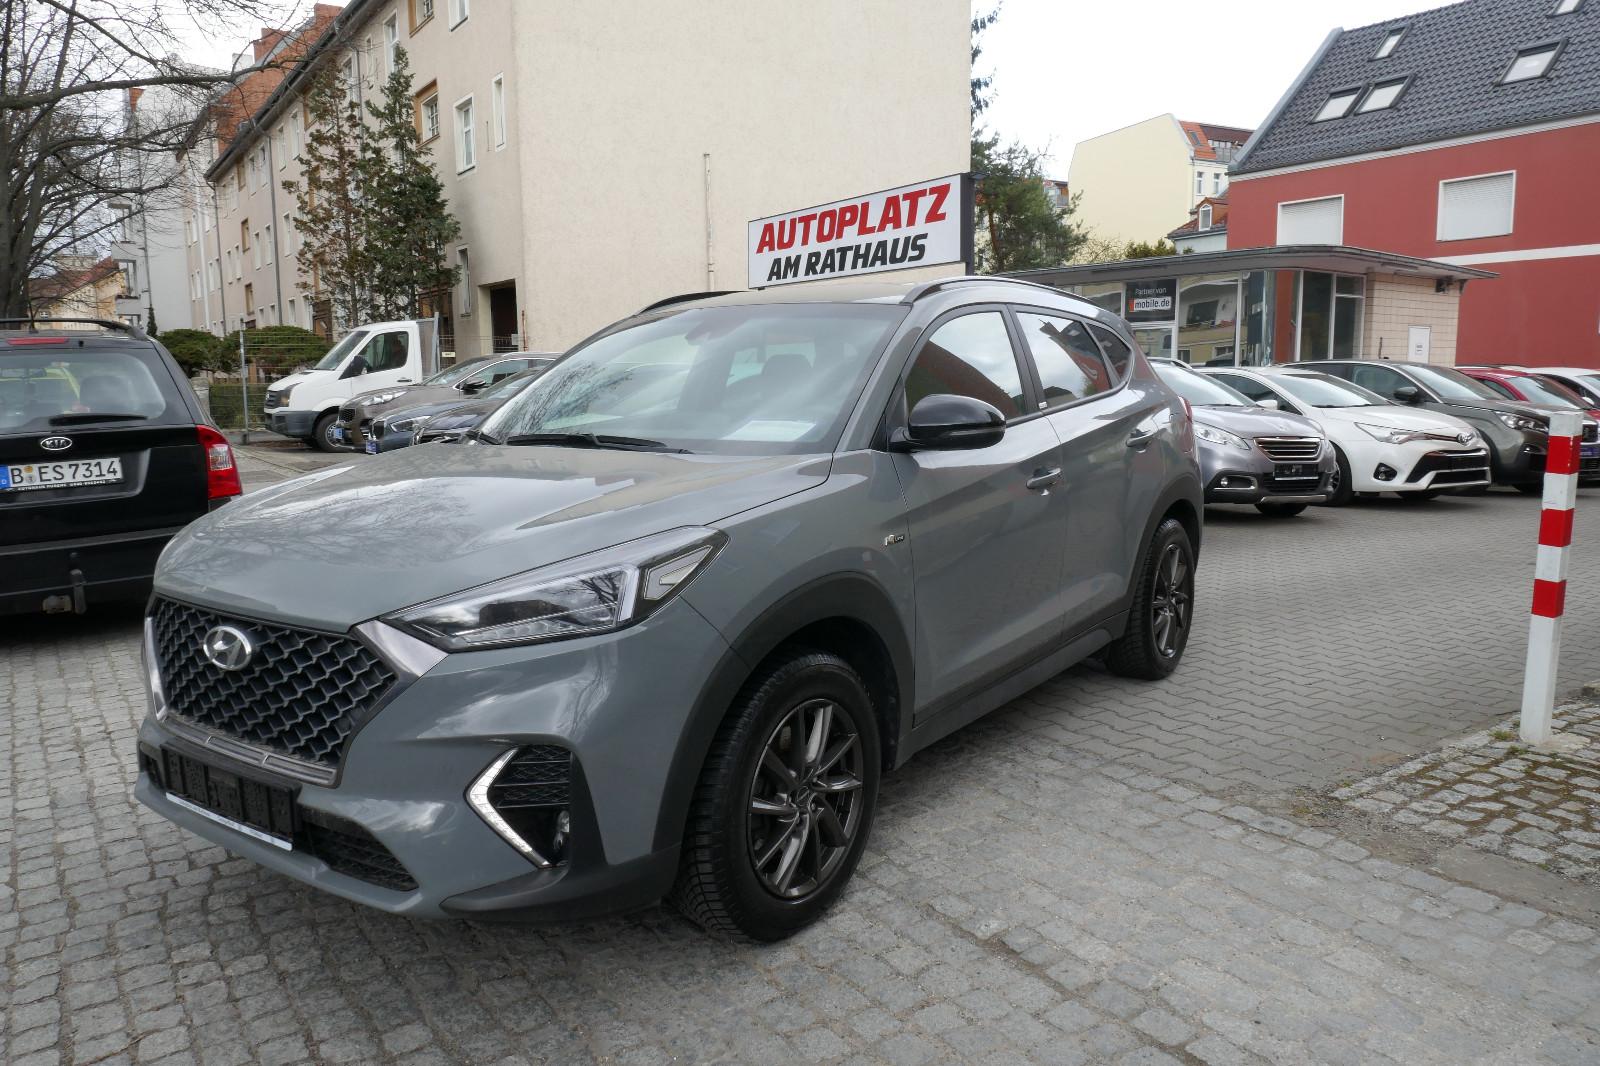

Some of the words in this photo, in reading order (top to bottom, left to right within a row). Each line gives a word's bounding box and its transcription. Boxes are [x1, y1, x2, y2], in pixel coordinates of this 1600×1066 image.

[756, 183, 951, 254] AUTOPLATZ
[767, 255, 802, 281] AM
[804, 233, 928, 276] RATHAUS
[1135, 298, 1170, 309] mobile.de
[44, 439, 68, 449] KIA
